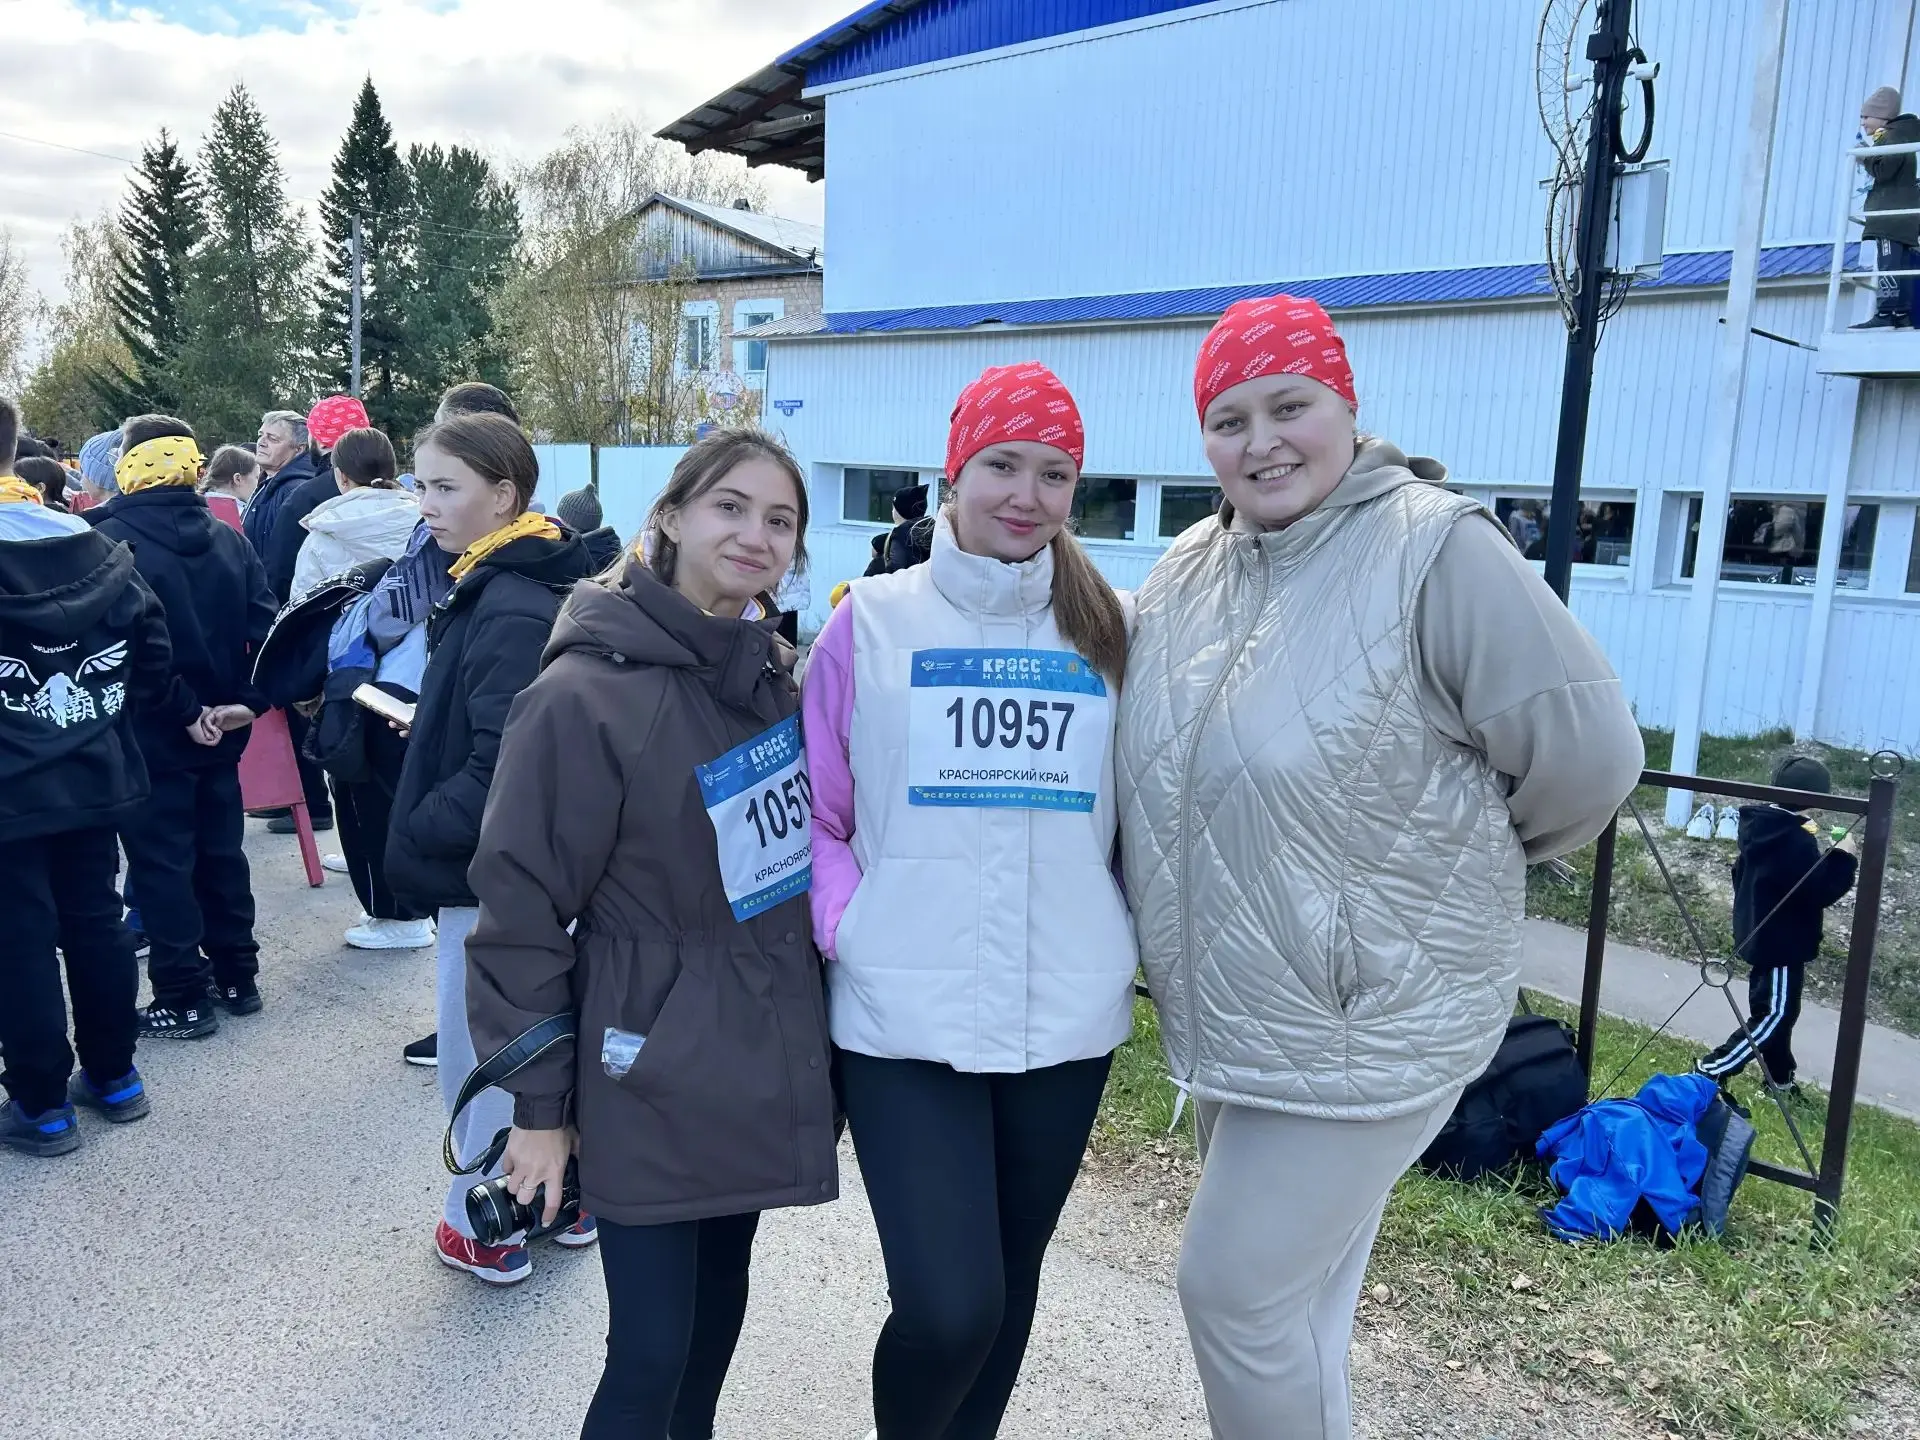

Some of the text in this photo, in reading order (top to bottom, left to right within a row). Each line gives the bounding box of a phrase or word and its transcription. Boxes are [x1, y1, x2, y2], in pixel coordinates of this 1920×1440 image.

[1240, 320, 1268, 340] КРОСС
[1245, 324, 1276, 345] НАЦИИ
[1286, 329, 1310, 341] КРОСС
[1291, 335, 1316, 347] НАЦИИ
[1241, 350, 1269, 376] КРОСС
[1246, 354, 1276, 379] НАЦИИ
[1282, 357, 1308, 373] КРОСС
[1206, 360, 1225, 388] КРОСС
[1211, 362, 1231, 392] НАЦИИ
[1007, 386, 1032, 400] КРОСС
[1010, 389, 1038, 404] НАЦИИ
[972, 413, 991, 438] КРОСС
[975, 415, 996, 441] НАЦИИ
[1003, 412, 1029, 430] КРОСС
[1006, 416, 1035, 436] НАЦИИ
[1038, 424, 1062, 437] КРОСС
[1041, 430, 1066, 442] НАЦИИ
[982, 657, 1041, 673] КРОСС
[983, 673, 1041, 681] НАЦИИ
[946, 697, 1075, 752] 10957
[749, 733, 788, 765] КРОСС
[755, 747, 792, 773] НАЦИИ
[939, 768, 1069, 784] КРАСНОЯРСКИЙ КРАЙ
[922, 792, 1025, 800] ВСЕРОССИЙСКИЙ
[1030, 794, 1058, 802] ДЕНЬ
